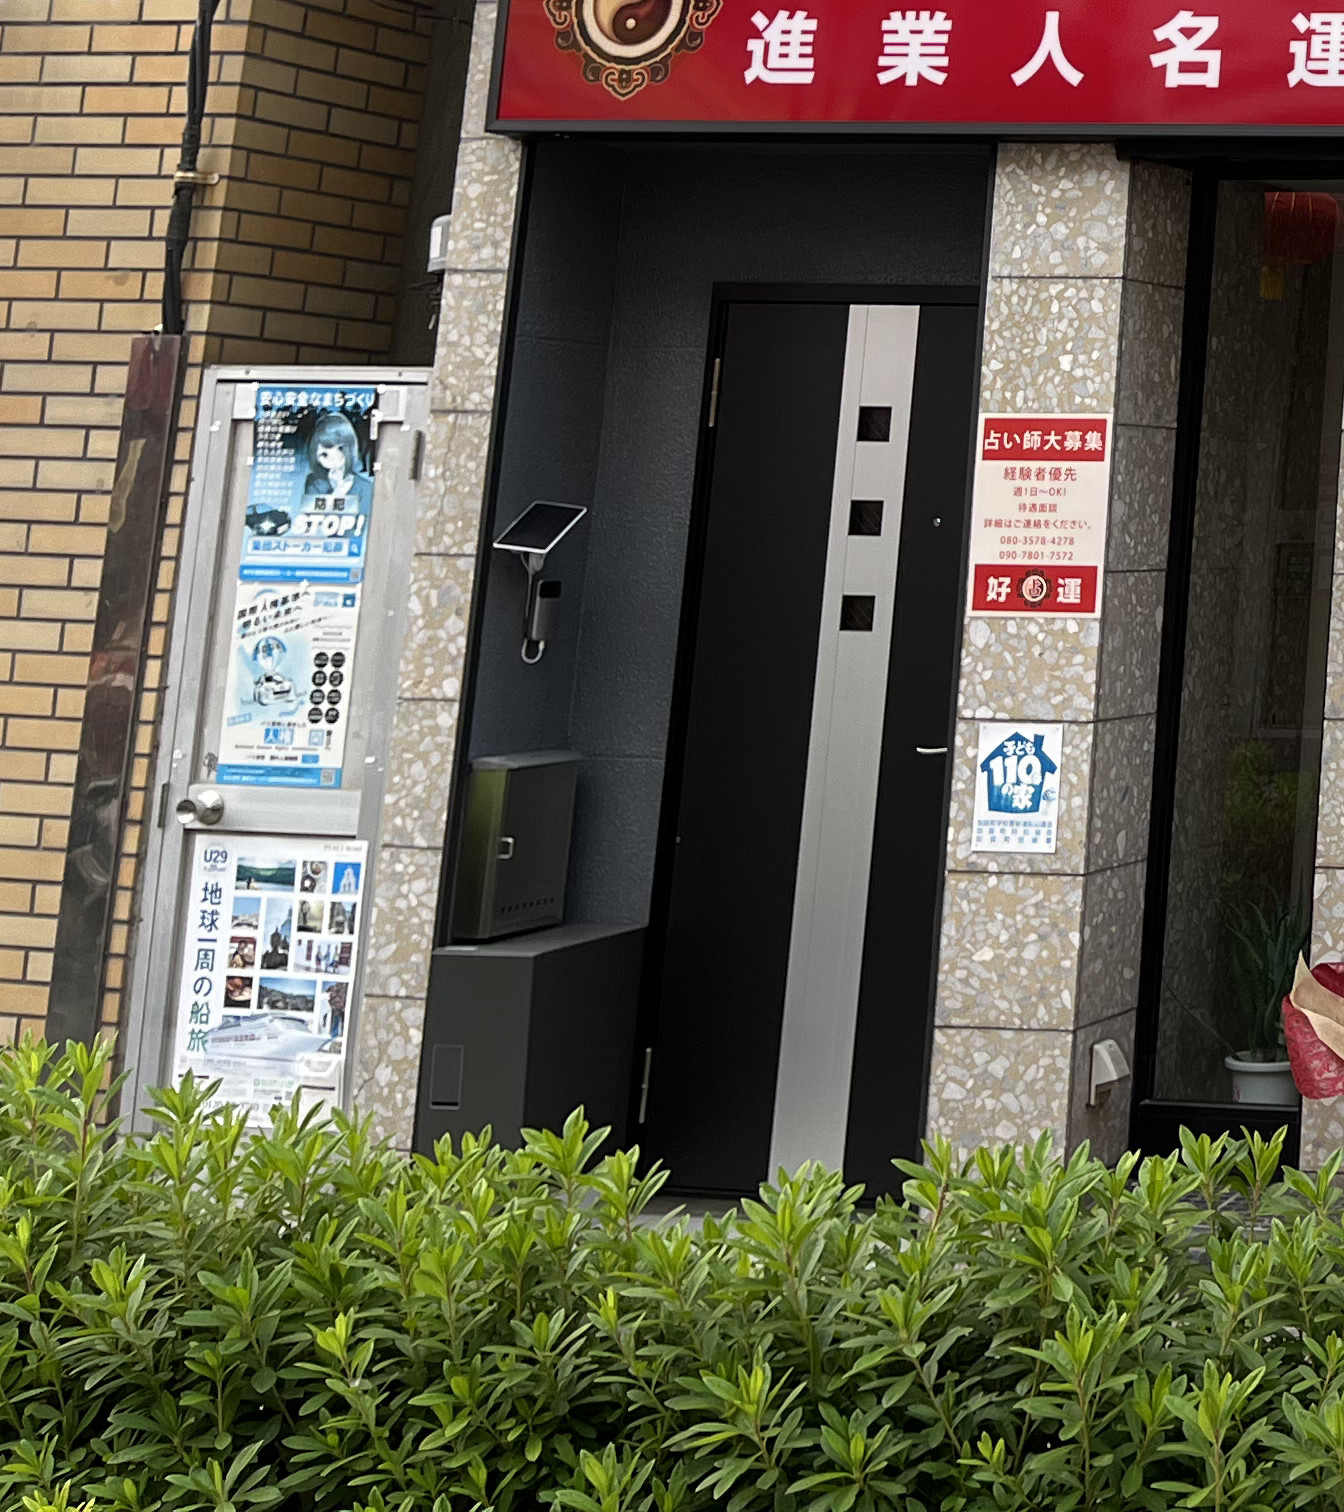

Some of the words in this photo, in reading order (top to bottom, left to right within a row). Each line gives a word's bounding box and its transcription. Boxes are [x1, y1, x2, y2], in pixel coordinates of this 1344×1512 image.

[983, 430, 1104, 452] 占い師大募集
[1003, 466, 1078, 482] 経験者優先
[292, 514, 366, 537] STOP!
[1000, 535, 1075, 546] 080-3578-4278
[999, 550, 1074, 561] 090-7801-7572
[203, 849, 228, 864] U29
[186, 880, 223, 1053] 地球一周の船旅
